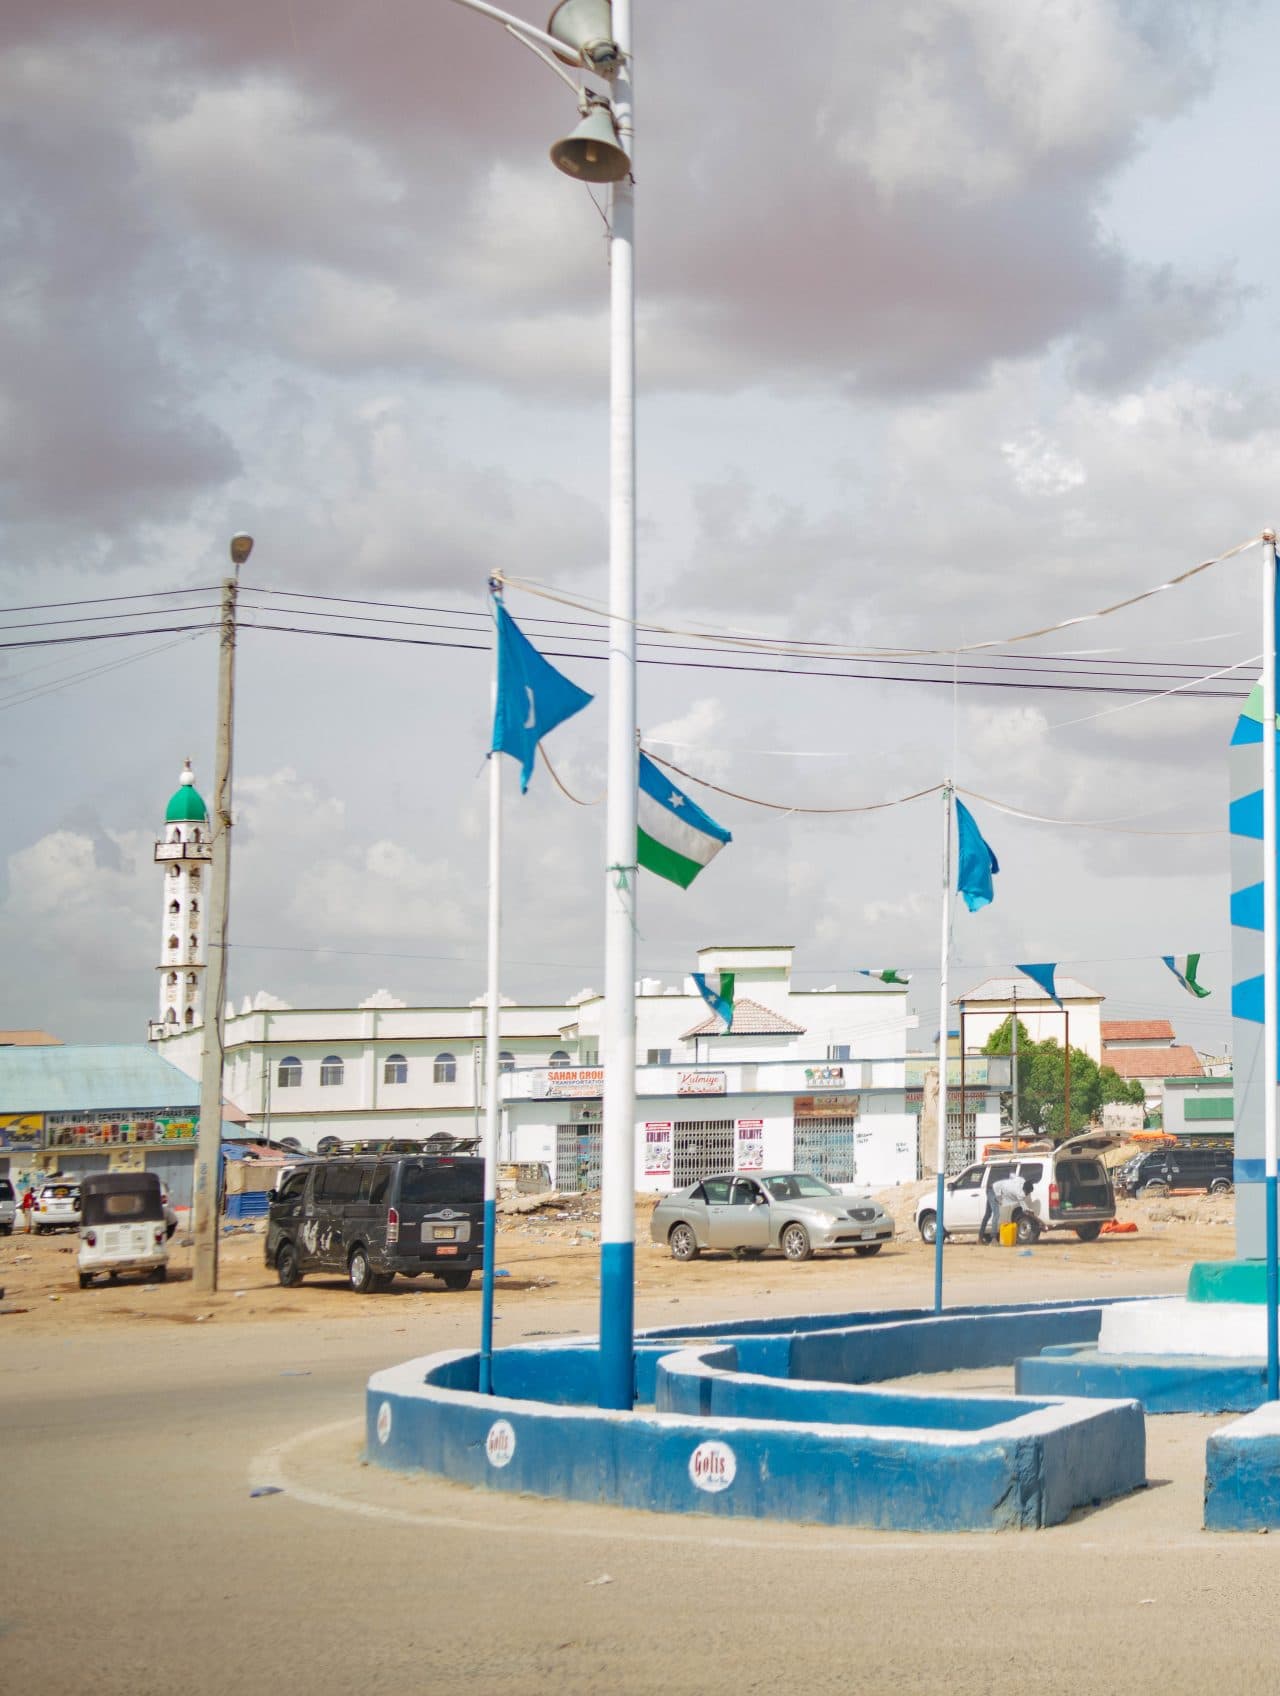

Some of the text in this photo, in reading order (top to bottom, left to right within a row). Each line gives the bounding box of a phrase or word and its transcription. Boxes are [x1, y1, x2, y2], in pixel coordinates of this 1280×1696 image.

[548, 1071, 604, 1081] SAHAN GROU
[695, 1450, 725, 1477] Golis
